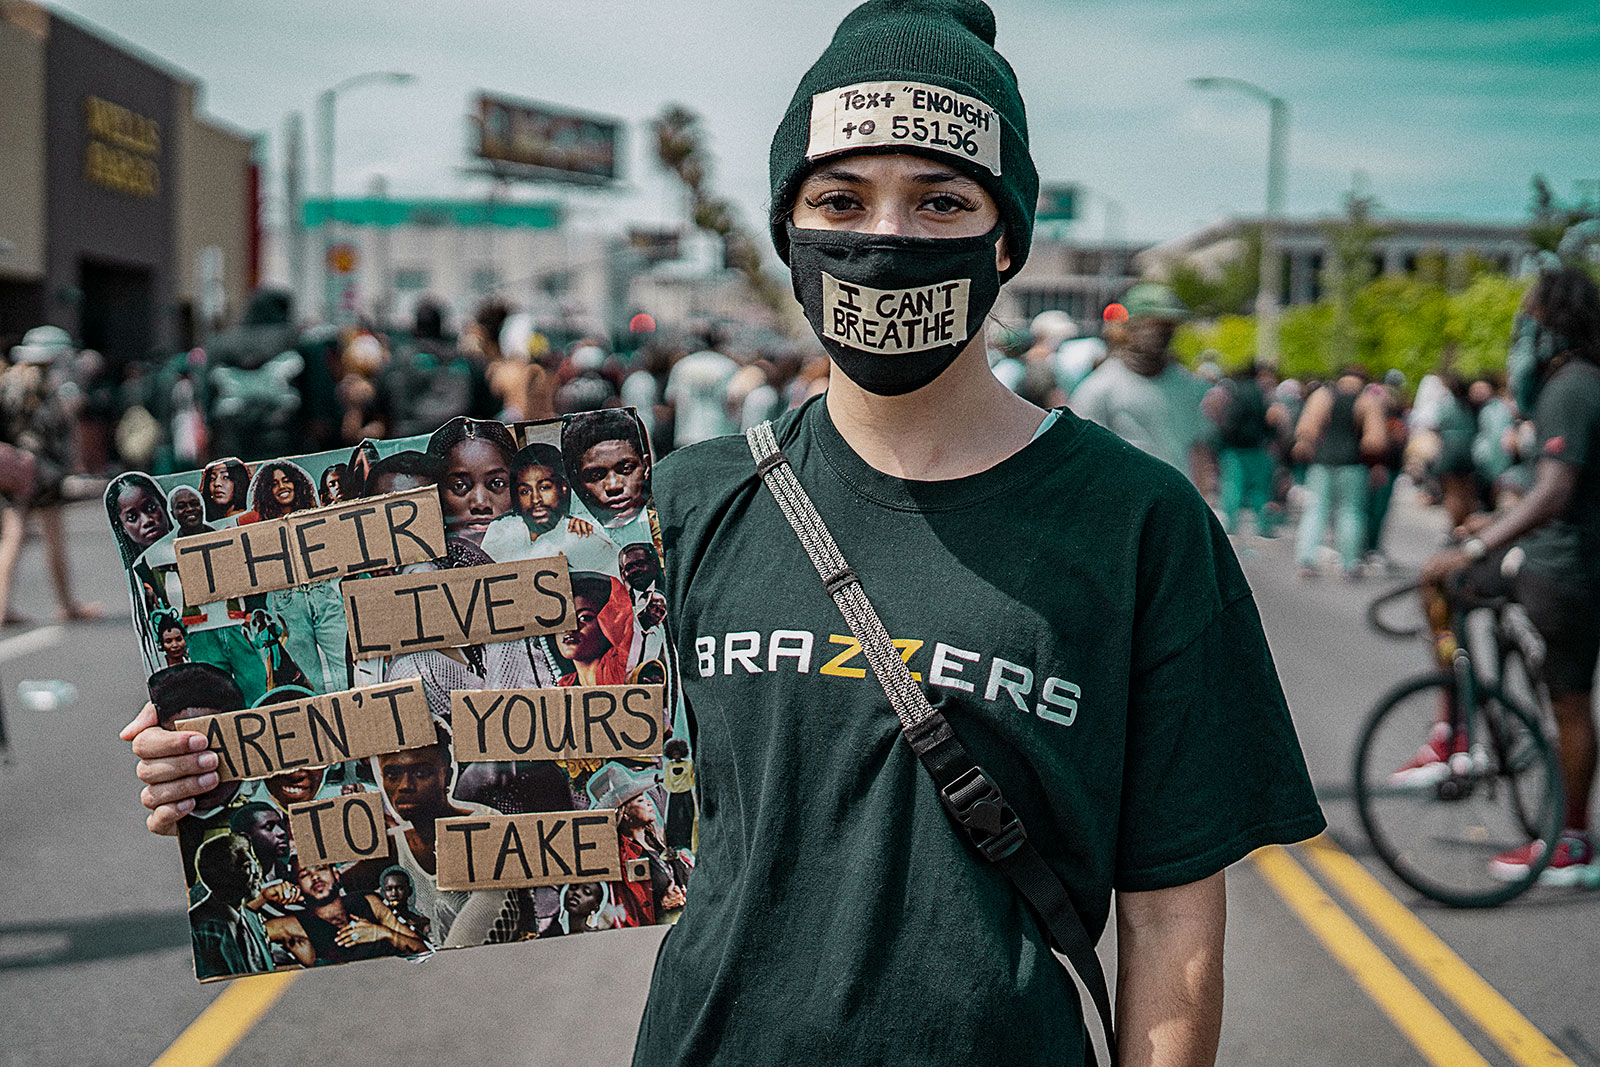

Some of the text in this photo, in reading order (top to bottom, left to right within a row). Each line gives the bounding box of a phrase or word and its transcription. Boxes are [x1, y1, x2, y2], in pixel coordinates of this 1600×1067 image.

[839, 89, 895, 111] Text
[842, 115, 979, 157] to 55156
[838, 282, 960, 319] I CAN'T
[833, 307, 955, 350] BREATHE
[180, 499, 438, 594] THEIR
[349, 570, 567, 654] LIVES
[205, 684, 659, 779] AREN'T YOURS
[291, 798, 380, 862] TO
